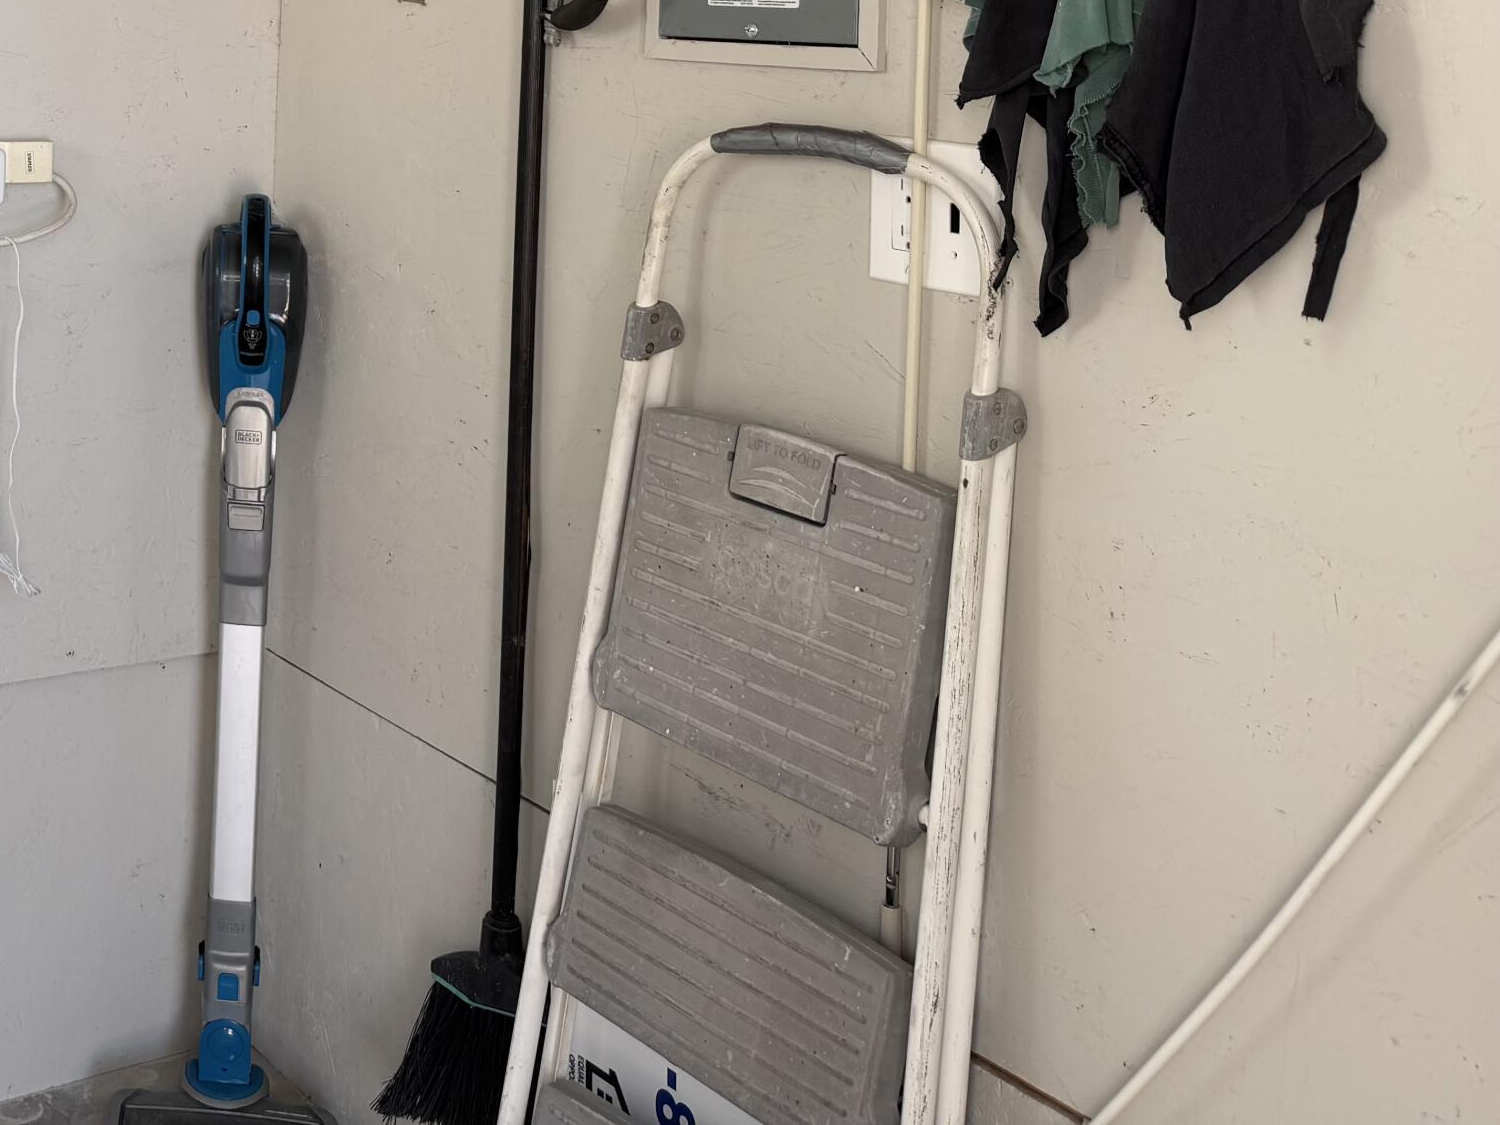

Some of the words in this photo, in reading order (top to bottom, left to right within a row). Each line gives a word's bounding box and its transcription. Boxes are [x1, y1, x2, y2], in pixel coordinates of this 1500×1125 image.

[747, 436, 771, 452] LIFT
[774, 443, 788, 459] TO
[791, 450, 820, 470] FOLD
